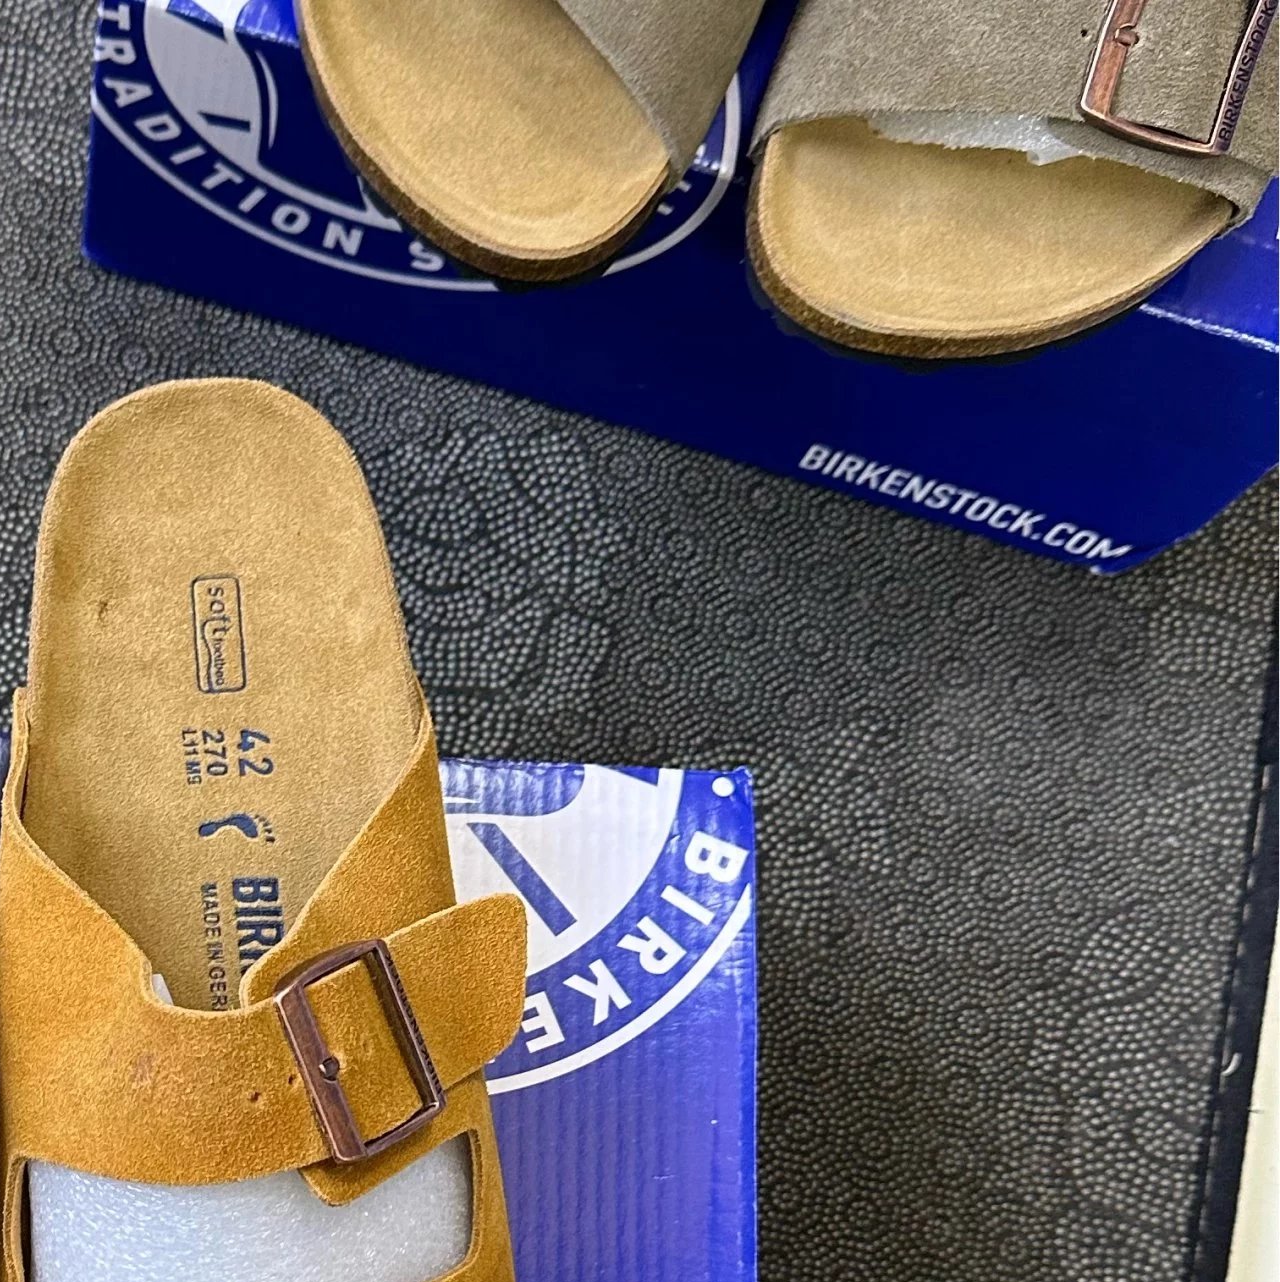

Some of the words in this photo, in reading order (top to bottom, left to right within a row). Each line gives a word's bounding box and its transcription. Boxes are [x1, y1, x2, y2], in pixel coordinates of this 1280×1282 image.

[93, 4, 365, 256] TRADITION
[798, 443, 1134, 559] BIRKENSTOCK.COM
[202, 586, 232, 635] soft
[202, 728, 228, 776] 270
[237, 728, 274, 776] 42
[202, 882, 221, 937] MADE
[232, 877, 284, 976] BIR
[521, 830, 750, 1054] BIRKE
[209, 965, 228, 1011] GER
